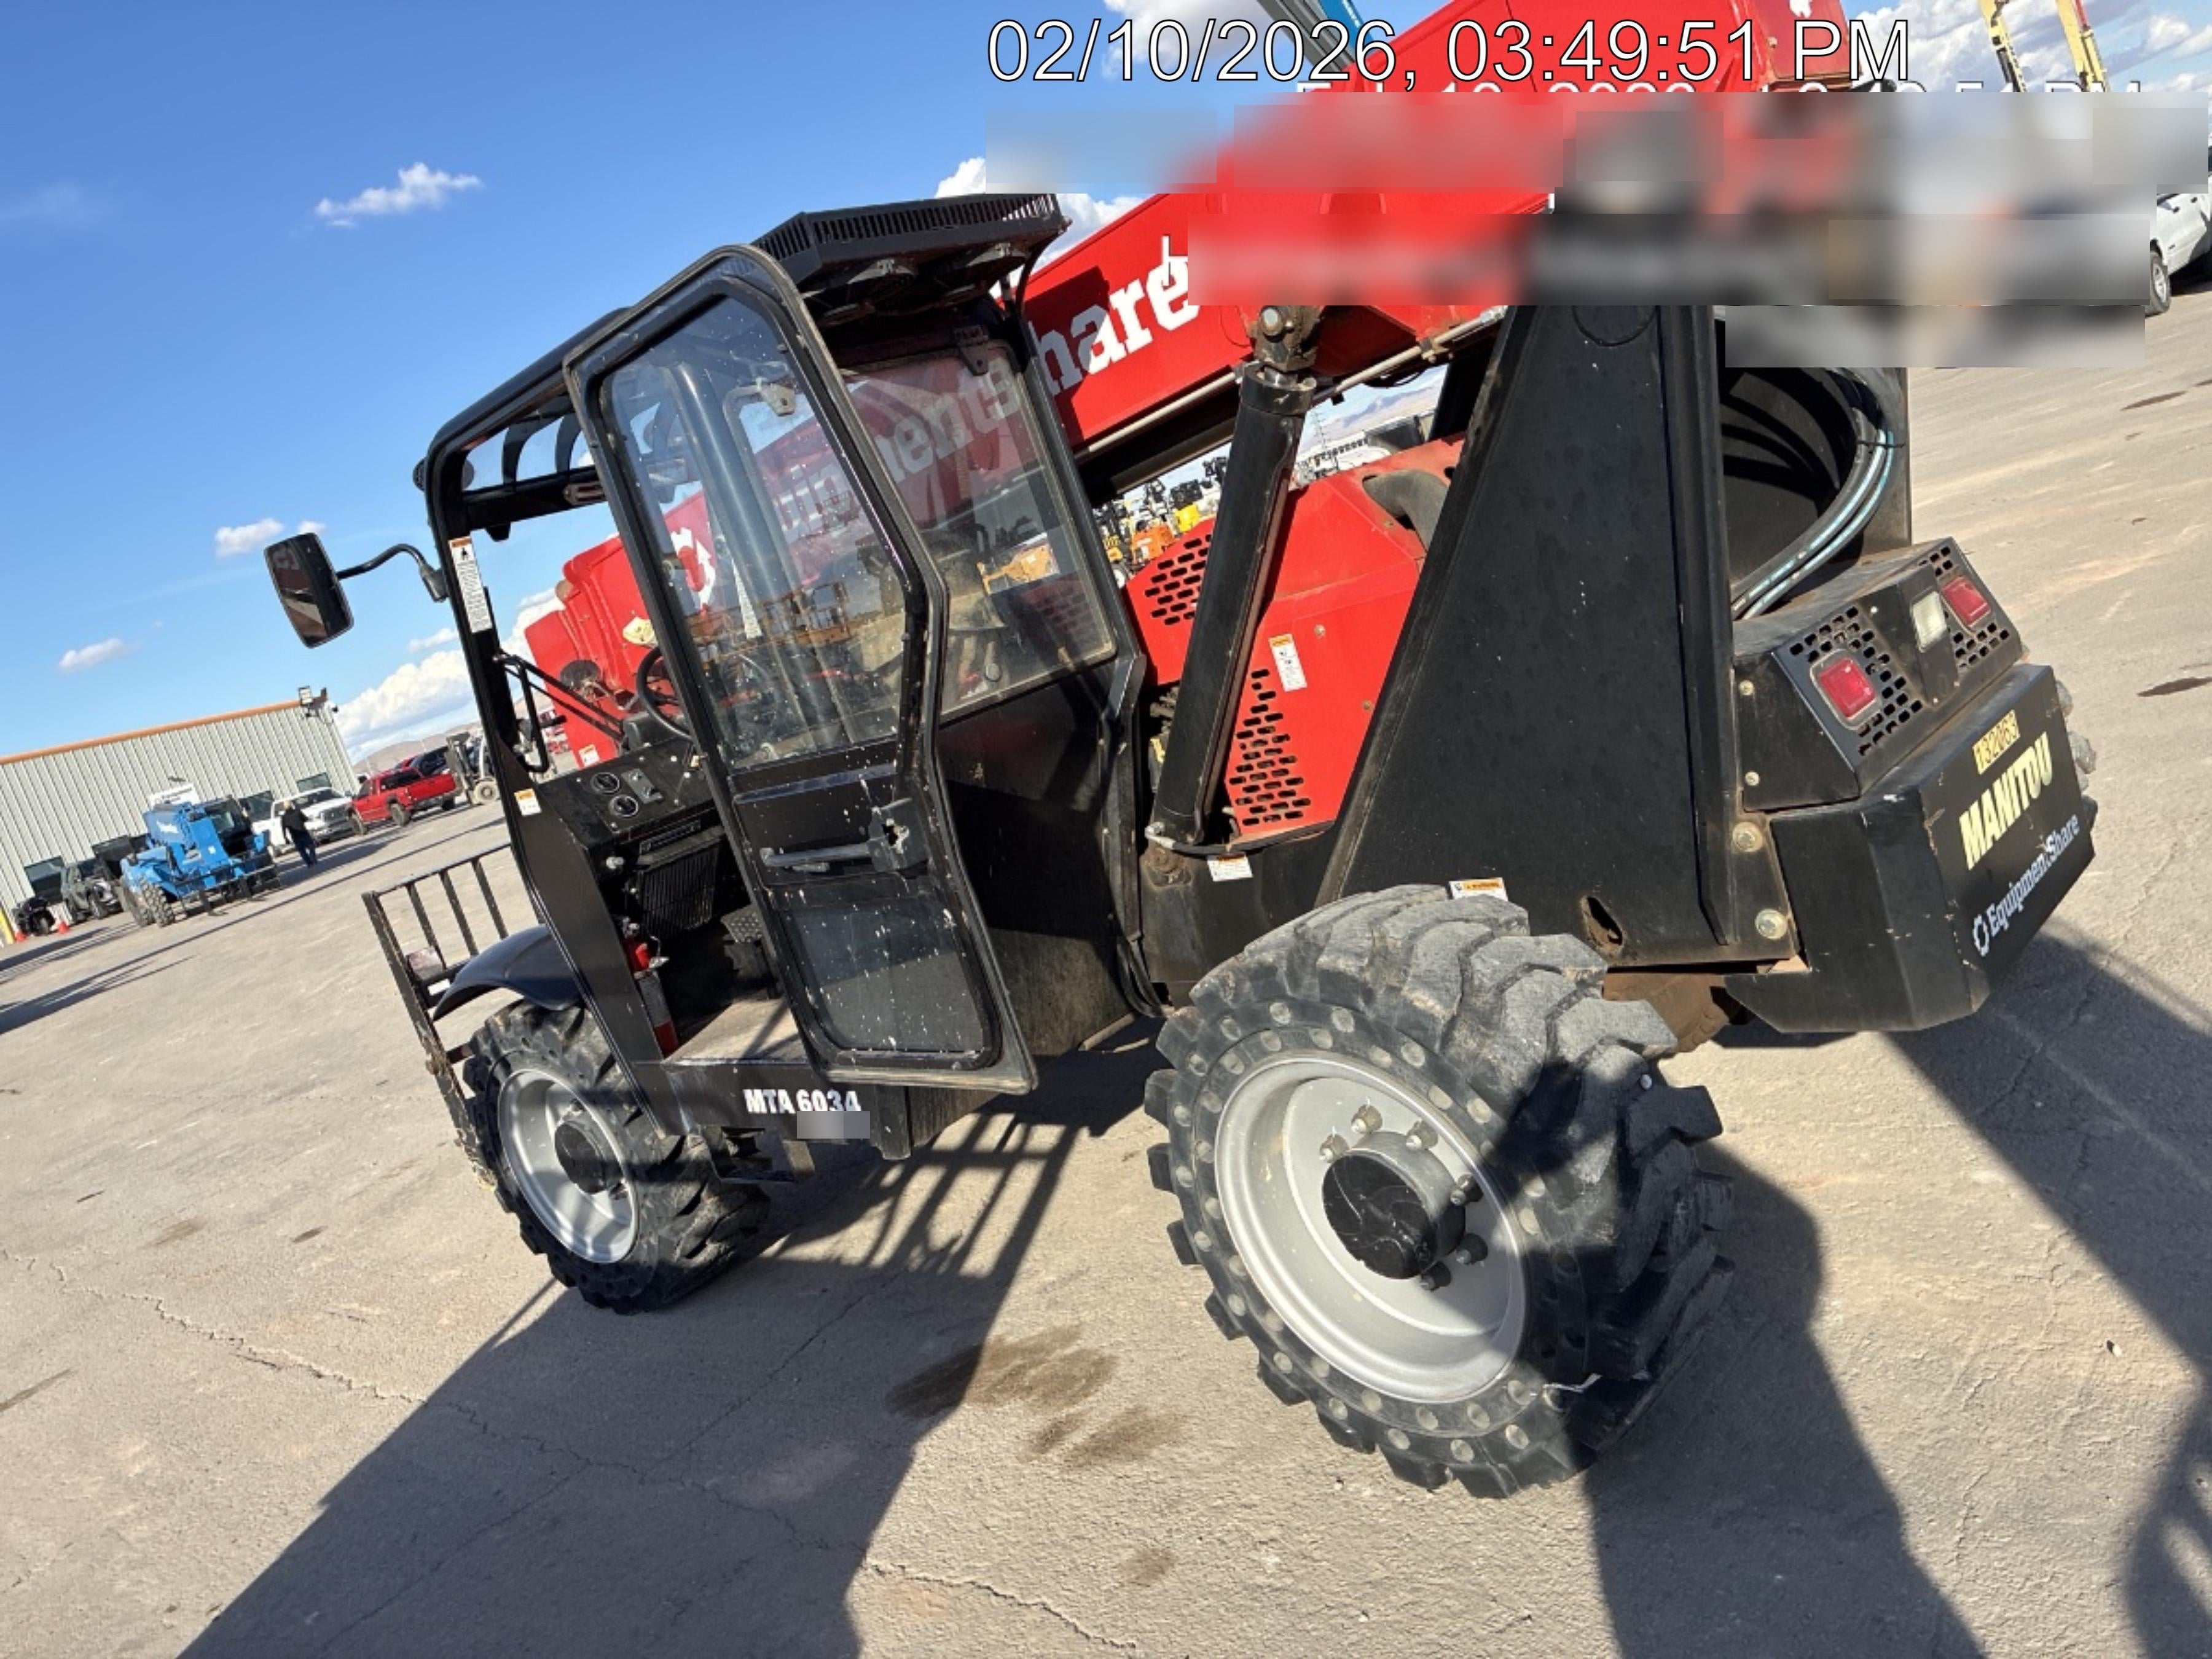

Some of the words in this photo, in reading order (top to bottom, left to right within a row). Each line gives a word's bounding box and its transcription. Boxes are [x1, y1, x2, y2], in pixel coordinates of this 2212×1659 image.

[1959, 731, 2053, 871] MANITOU
[742, 1089, 796, 1114] MTA
[796, 1089, 862, 1112] 6034
